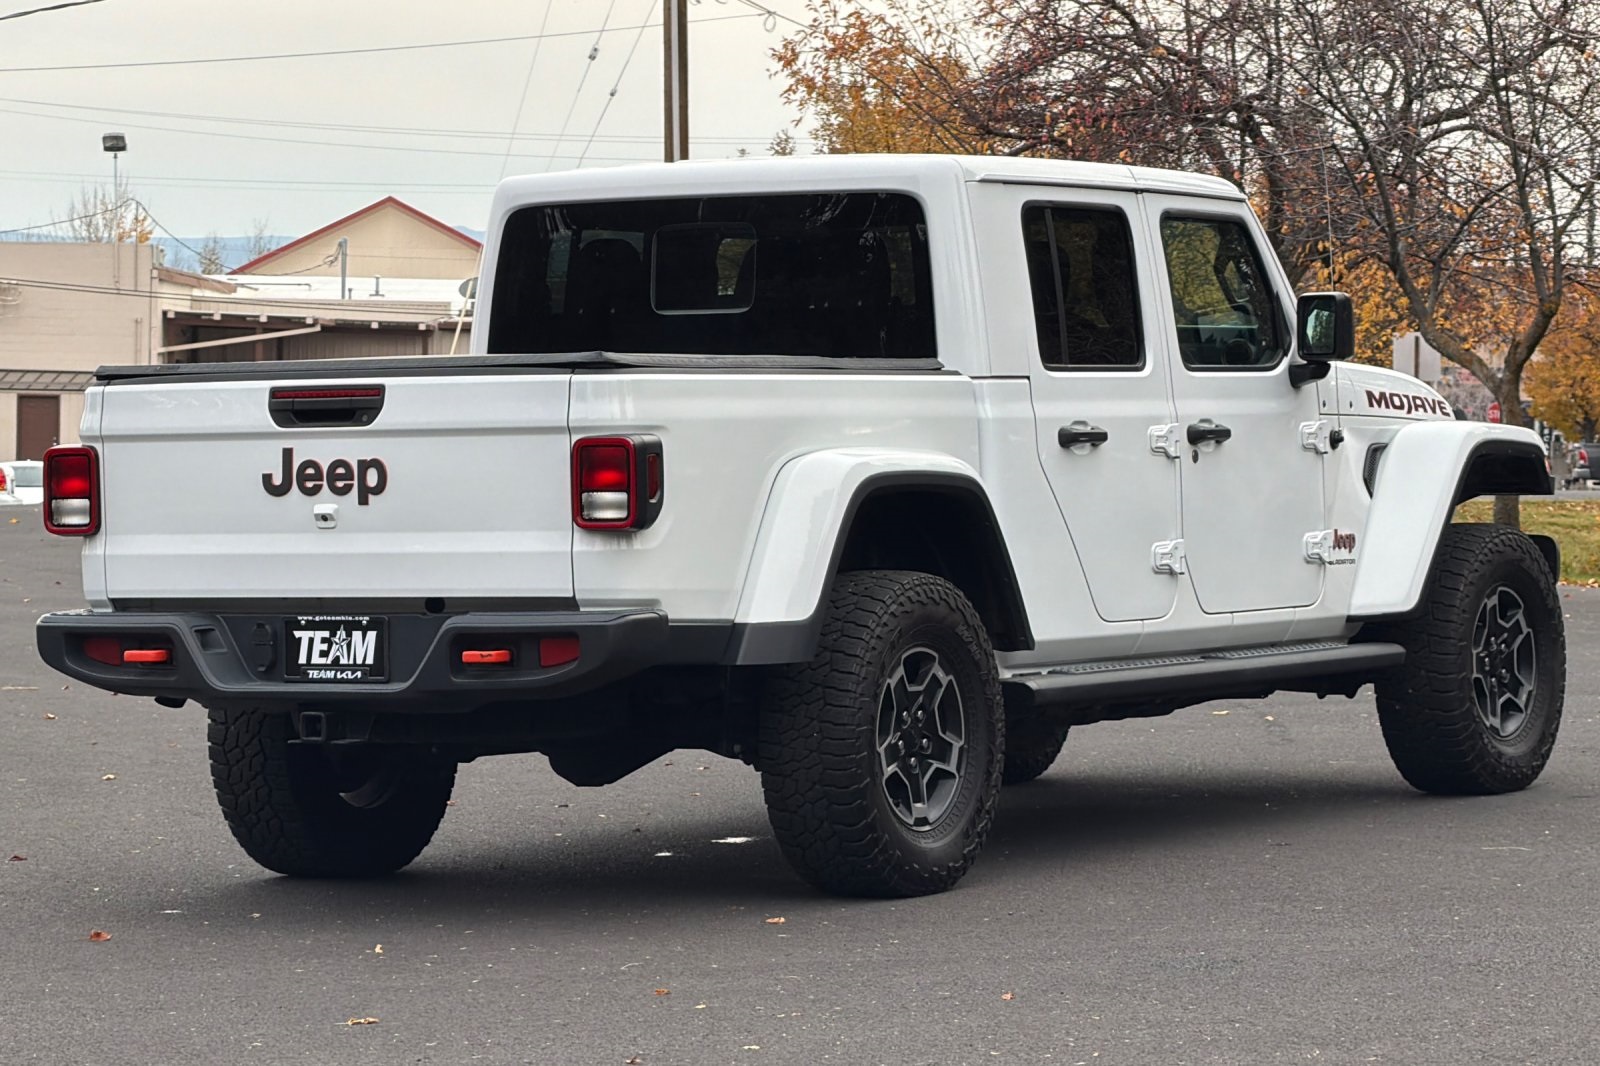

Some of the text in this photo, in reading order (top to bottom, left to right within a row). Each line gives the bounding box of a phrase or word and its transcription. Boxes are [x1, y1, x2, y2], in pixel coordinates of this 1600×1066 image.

[1365, 389, 1451, 418] MOJAVE
[262, 447, 388, 506] Jeep
[1332, 528, 1356, 554] Jeep
[292, 629, 378, 665] TEAM
[307, 670, 336, 679] TEAM
